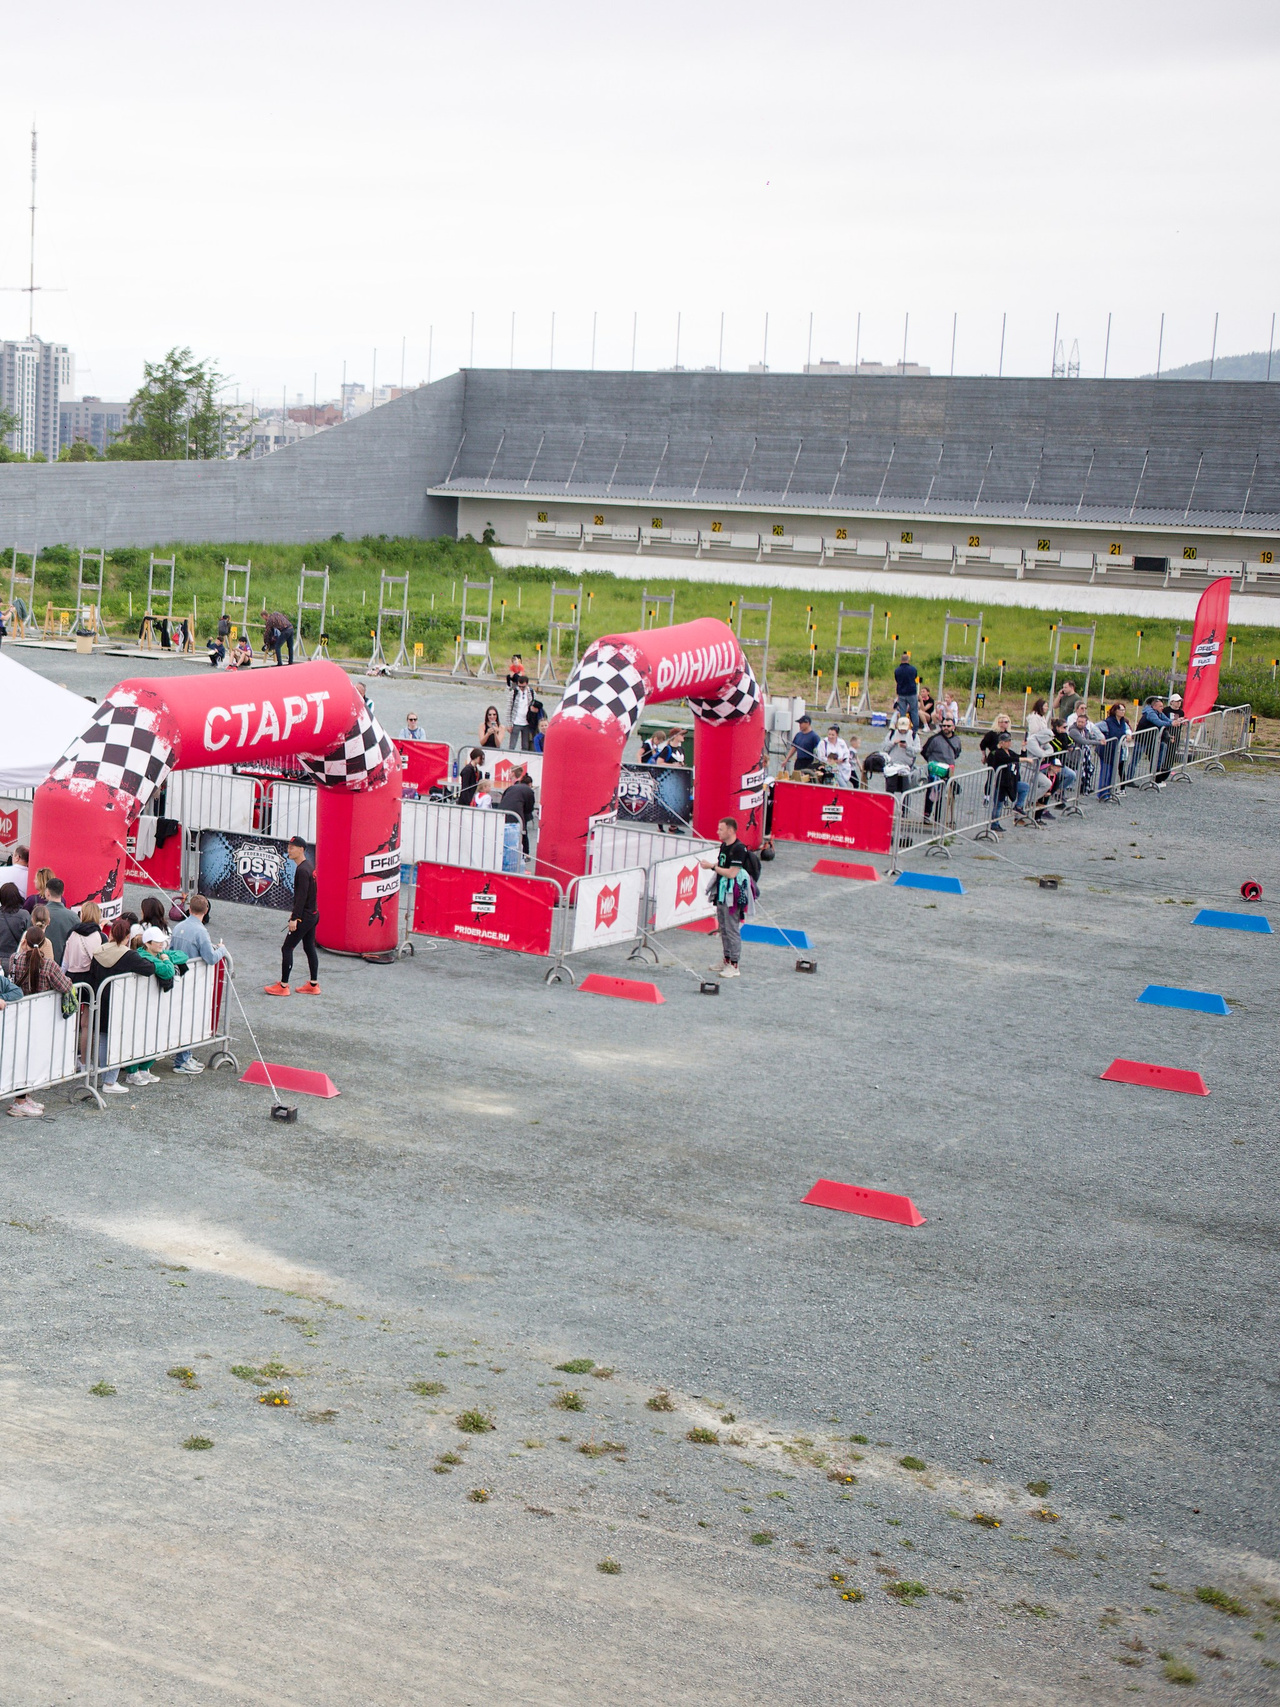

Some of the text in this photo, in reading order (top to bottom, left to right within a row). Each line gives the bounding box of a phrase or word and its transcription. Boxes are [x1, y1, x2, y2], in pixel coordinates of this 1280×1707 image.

[594, 515, 604, 525] 29
[712, 522, 722, 532] 27
[773, 525, 783, 536] 26
[836, 529, 847, 539] 25
[902, 533, 912, 543] 24
[969, 536, 980, 547] 23
[1038, 540, 1050, 551] 22
[1111, 544, 1122, 555] 21
[1184, 548, 1196, 559] 20
[1261, 551, 1273, 563] 19
[657, 640, 735, 692] ФИНИШ
[203, 690, 330, 752] СТАРТ
[807, 830, 855, 845] PRIDERACE.RU
[243, 851, 275, 860] FEDERATION
[239, 857, 279, 882] OSR
[680, 874, 695, 894] МИР
[600, 895, 615, 915] МИР
[454, 925, 510, 942] PRIDERACE.RU
